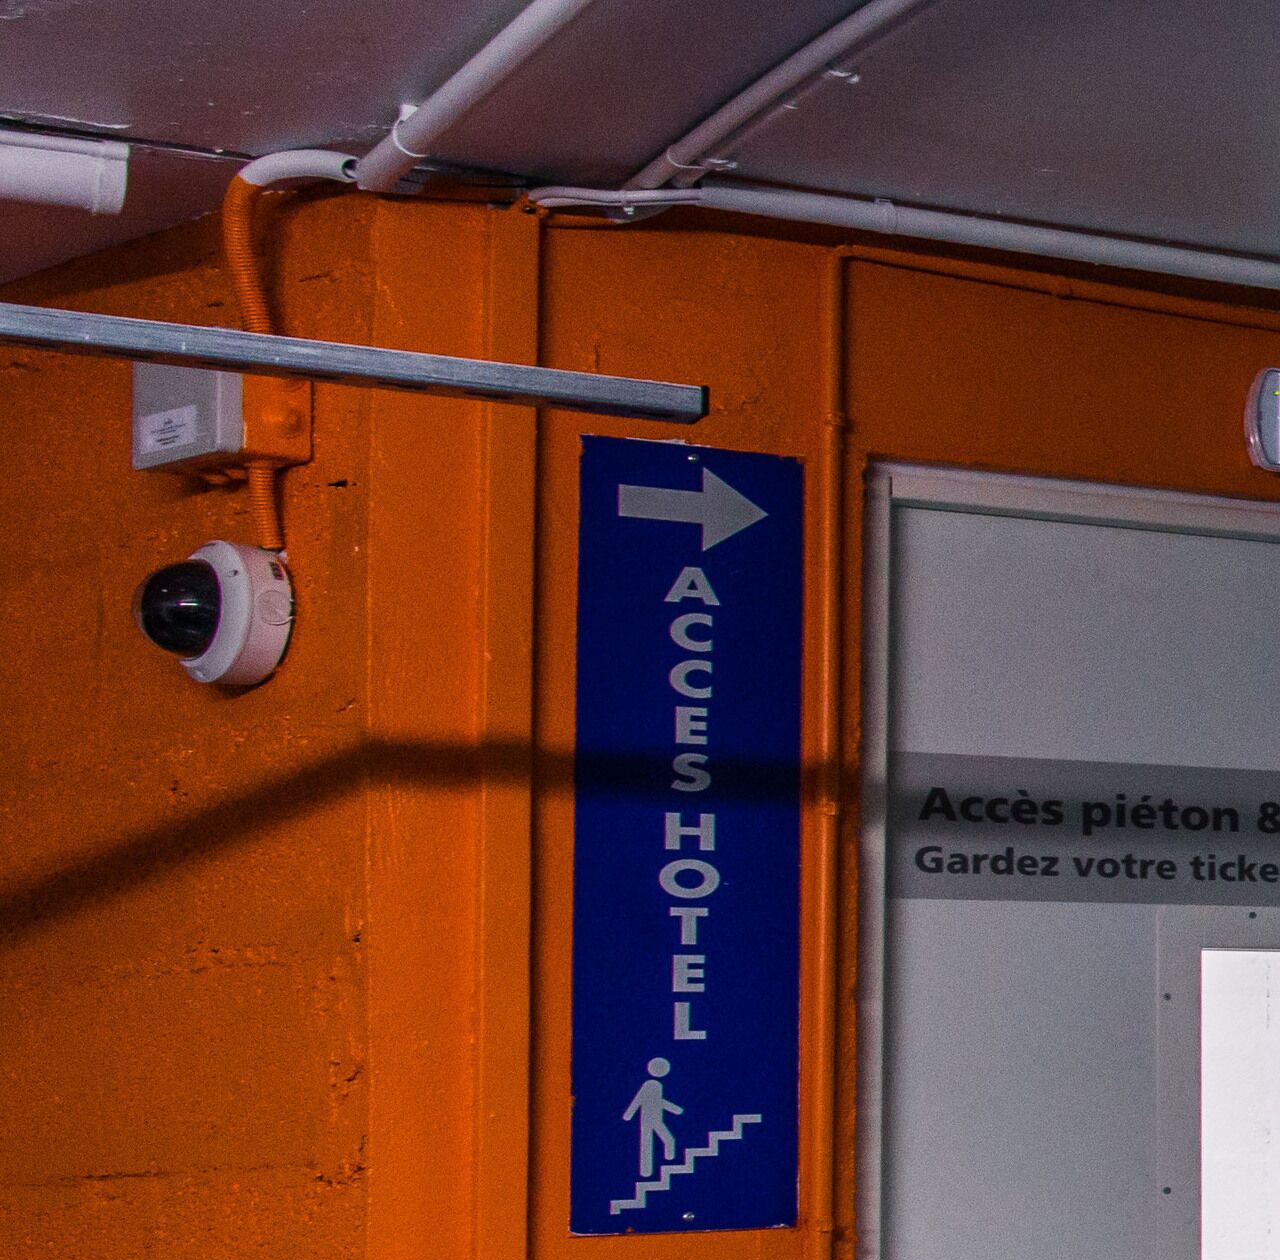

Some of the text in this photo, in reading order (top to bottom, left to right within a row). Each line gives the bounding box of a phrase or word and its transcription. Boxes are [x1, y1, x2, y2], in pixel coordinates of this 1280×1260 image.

[664, 566, 720, 792] ACCES
[915, 845, 1060, 878] Gardez
[1073, 853, 1178, 881] votre
[918, 786, 1065, 826] Accès
[1082, 793, 1240, 837] piéton
[658, 811, 720, 1041] HOTEL
